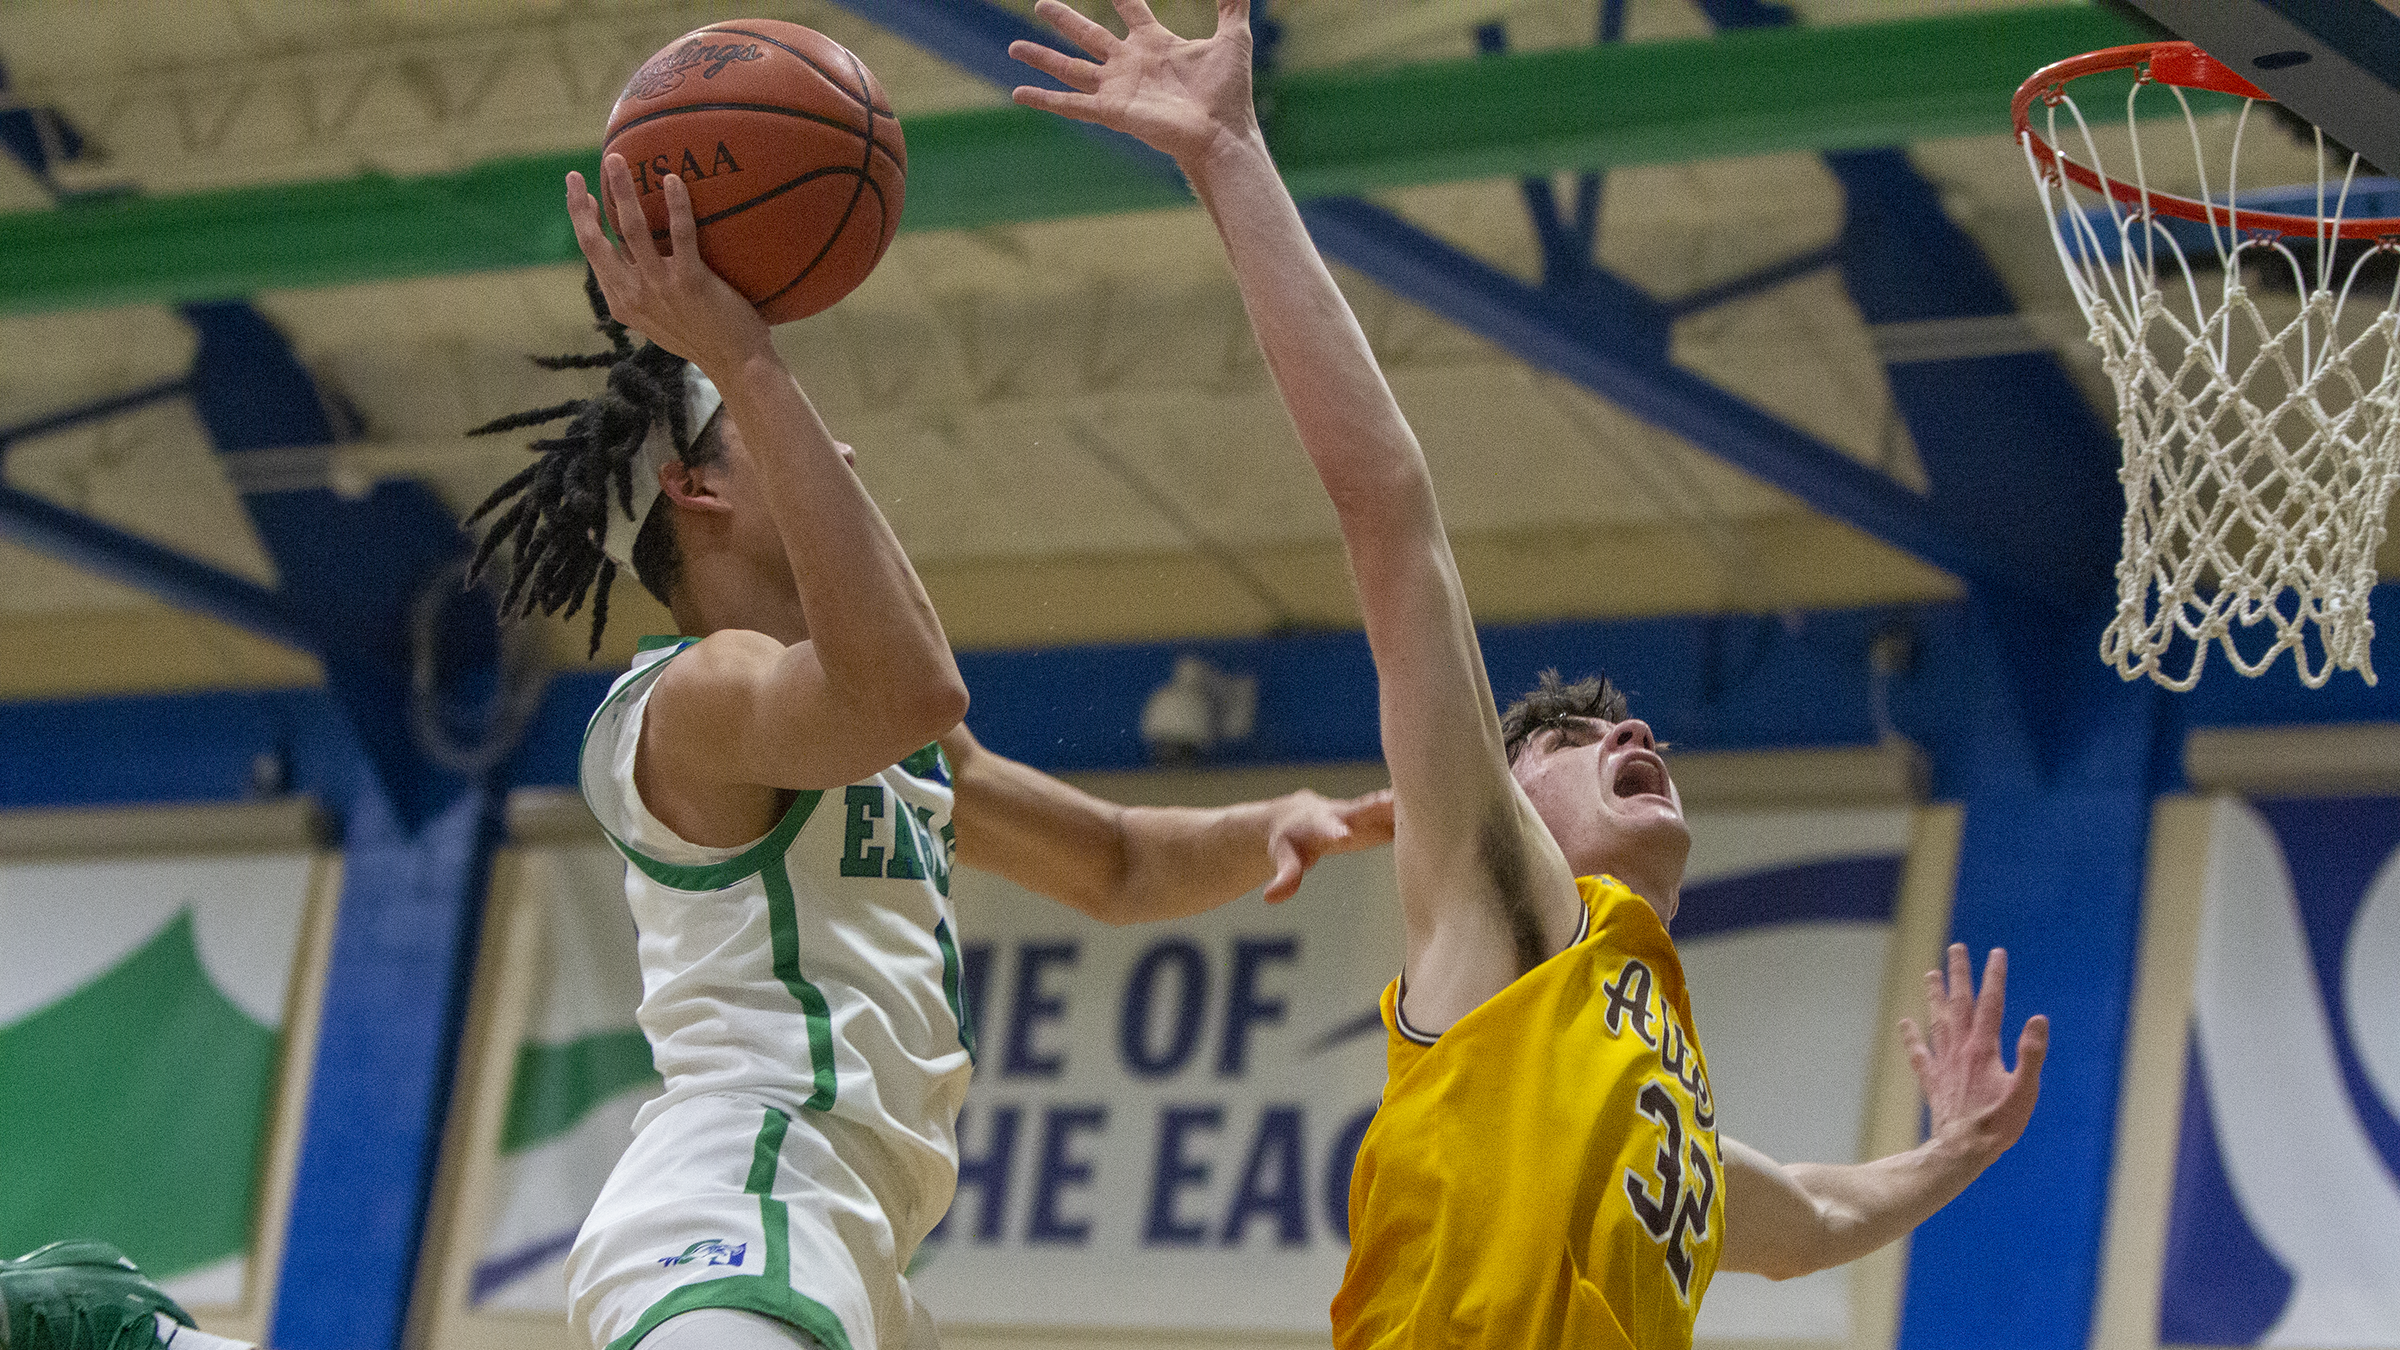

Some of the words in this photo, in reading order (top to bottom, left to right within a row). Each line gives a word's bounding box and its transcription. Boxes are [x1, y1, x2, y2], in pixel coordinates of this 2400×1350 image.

[607, 141, 744, 208] HSAA
[1120, 935, 1304, 1080] OF
[933, 1105, 1107, 1246] HE
[1623, 1078, 1716, 1304] 32
